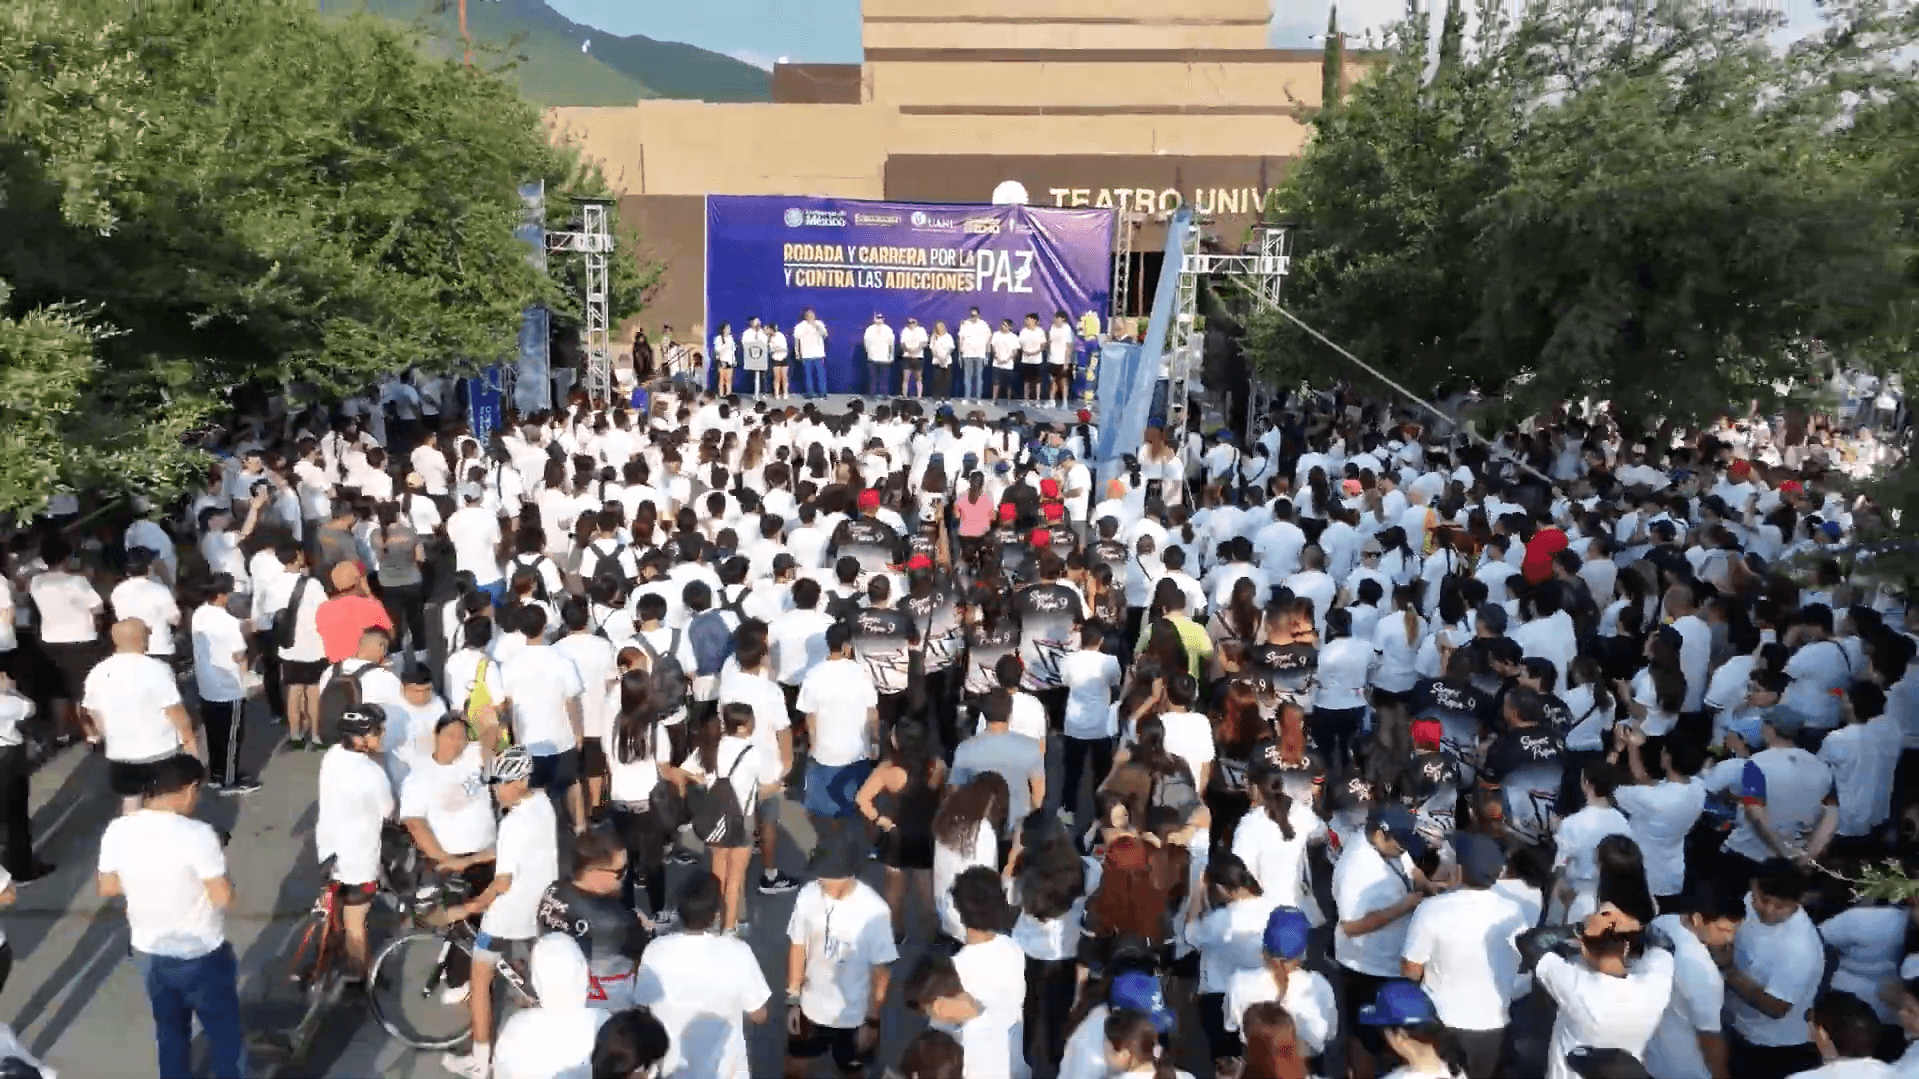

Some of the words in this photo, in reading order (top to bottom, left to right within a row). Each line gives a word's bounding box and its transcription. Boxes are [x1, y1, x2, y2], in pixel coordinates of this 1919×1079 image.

[1049, 187, 1184, 214] TEATRO
[783, 243, 844, 262] RODADA
[847, 245, 857, 263] Y
[859, 246, 927, 267] CARRERA
[930, 247, 956, 266] POR
[959, 248, 975, 267] LA
[976, 248, 1034, 293] PAZ
[783, 268, 792, 288] Y
[795, 269, 855, 288] CONTRA
[858, 271, 883, 289] LAS
[885, 270, 976, 293] ADICCIONES
[1058, 597, 1068, 610] 9
[887, 622, 896, 634] 9
[1298, 655, 1307, 667] 9
[1258, 678, 1267, 692] 9
[1467, 697, 1477, 711] 9
[575, 919, 589, 937] 9
